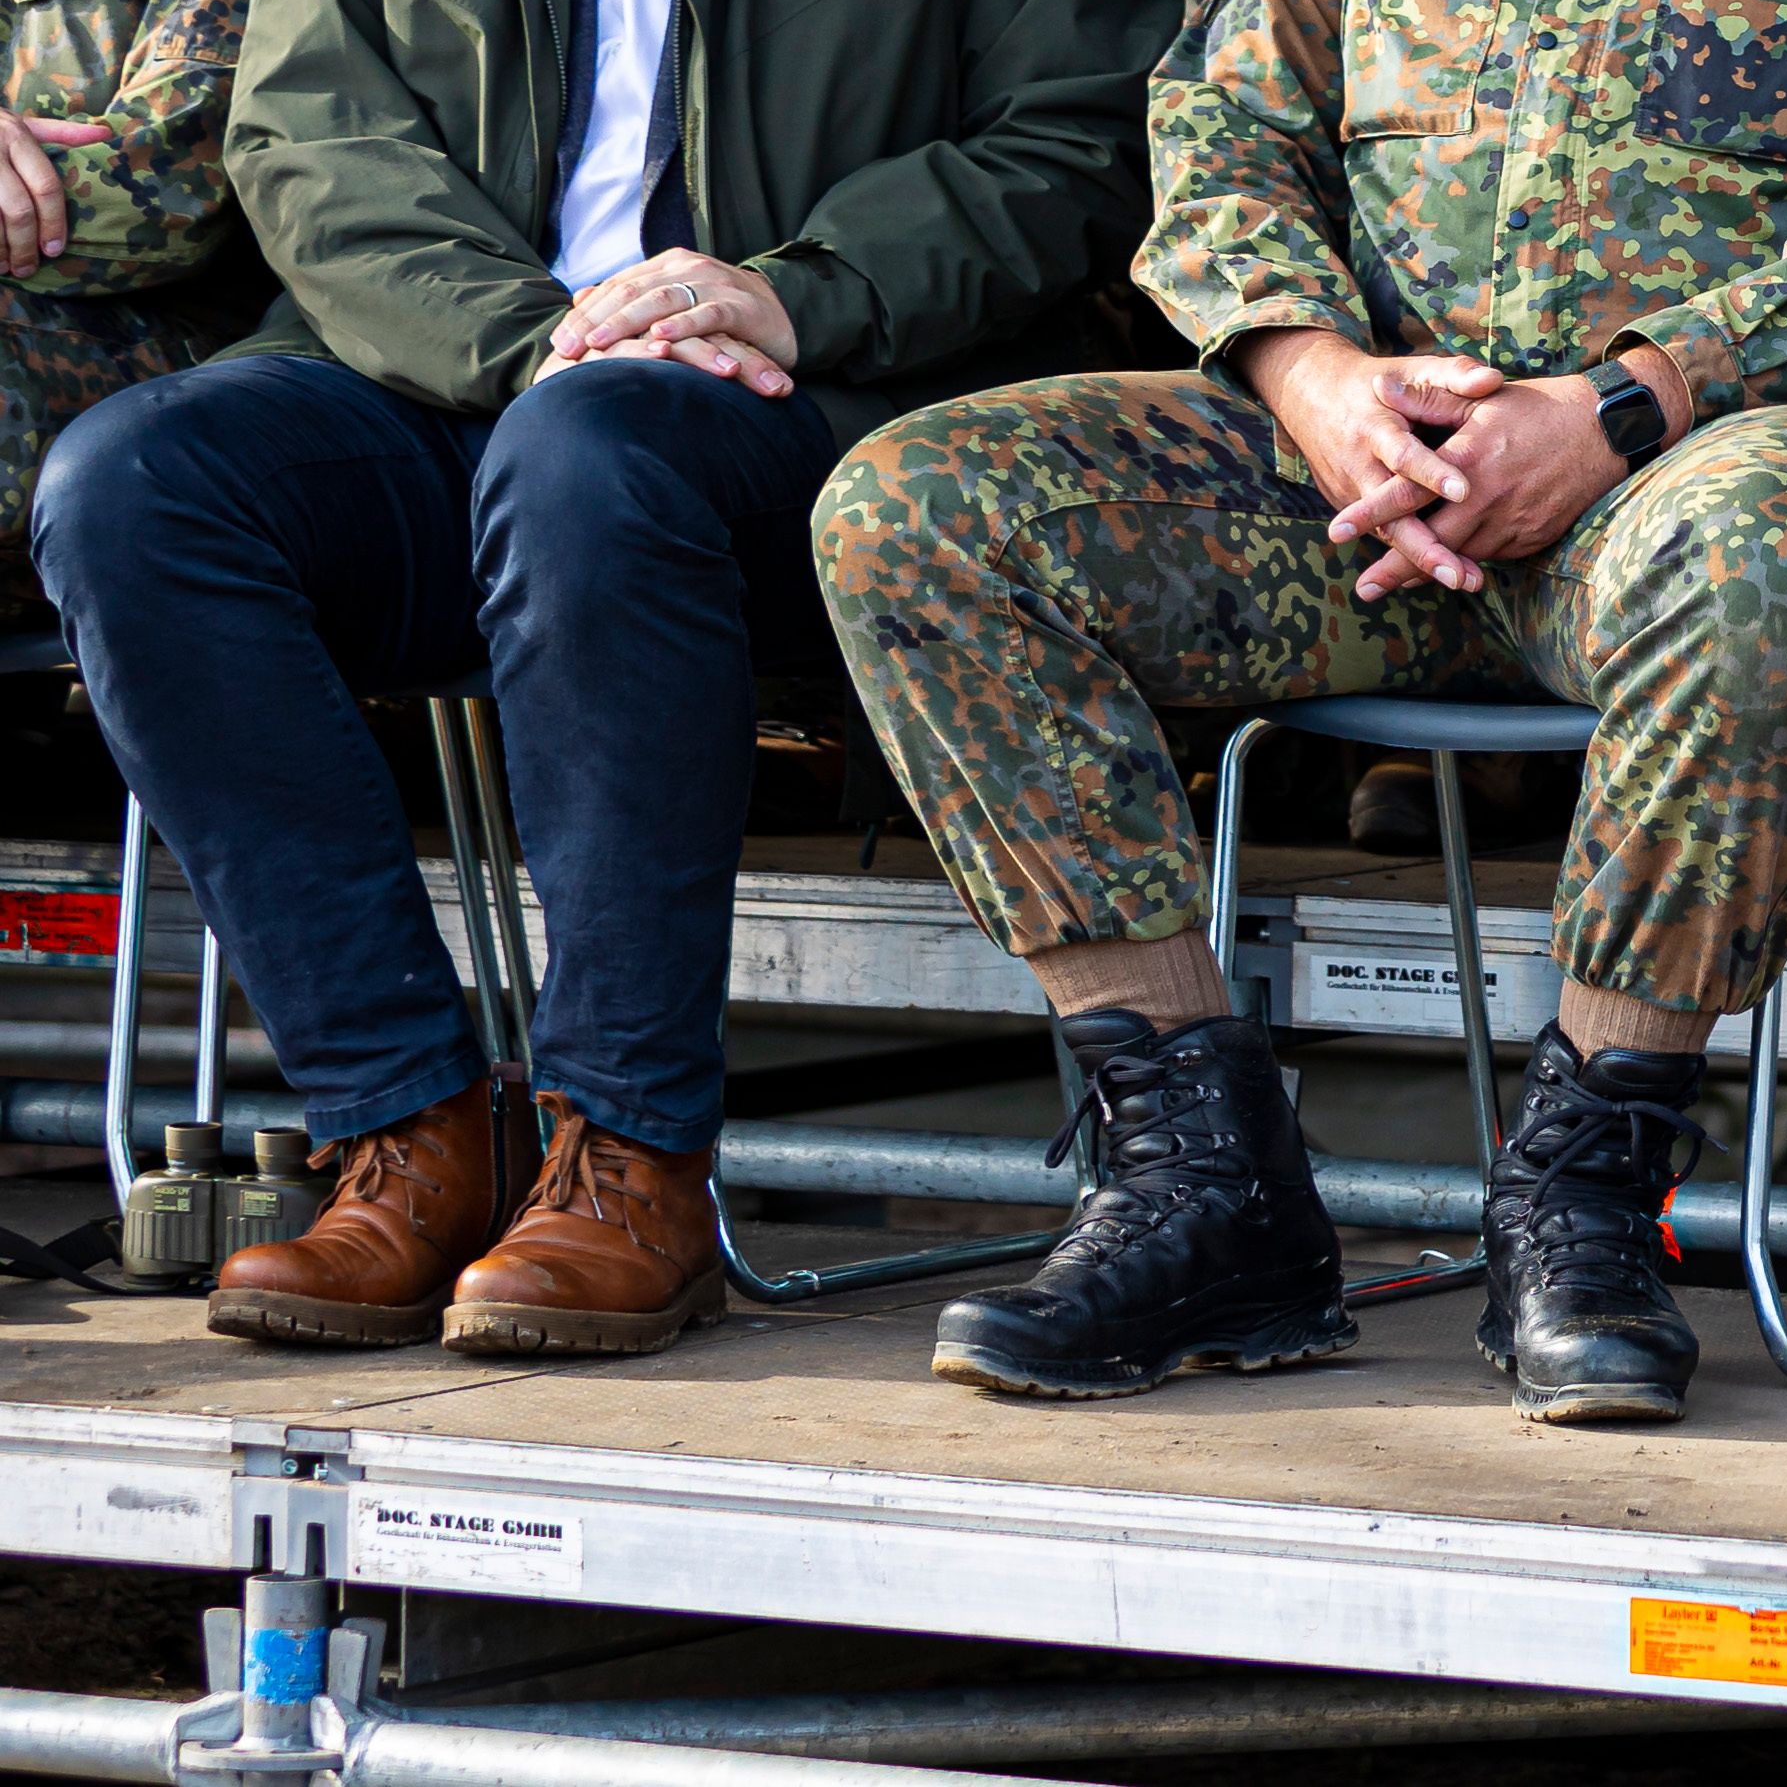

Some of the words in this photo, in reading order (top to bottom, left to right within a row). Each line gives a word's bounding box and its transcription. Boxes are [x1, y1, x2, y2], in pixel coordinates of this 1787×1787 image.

[1327, 964, 1369, 979] DOC.
[1375, 967, 1435, 983] STAGE
[1441, 970, 1497, 986] GH
[377, 1508, 423, 1525] DOC.
[430, 1512, 495, 1533] STAGE
[502, 1519, 563, 1539] GMBH
